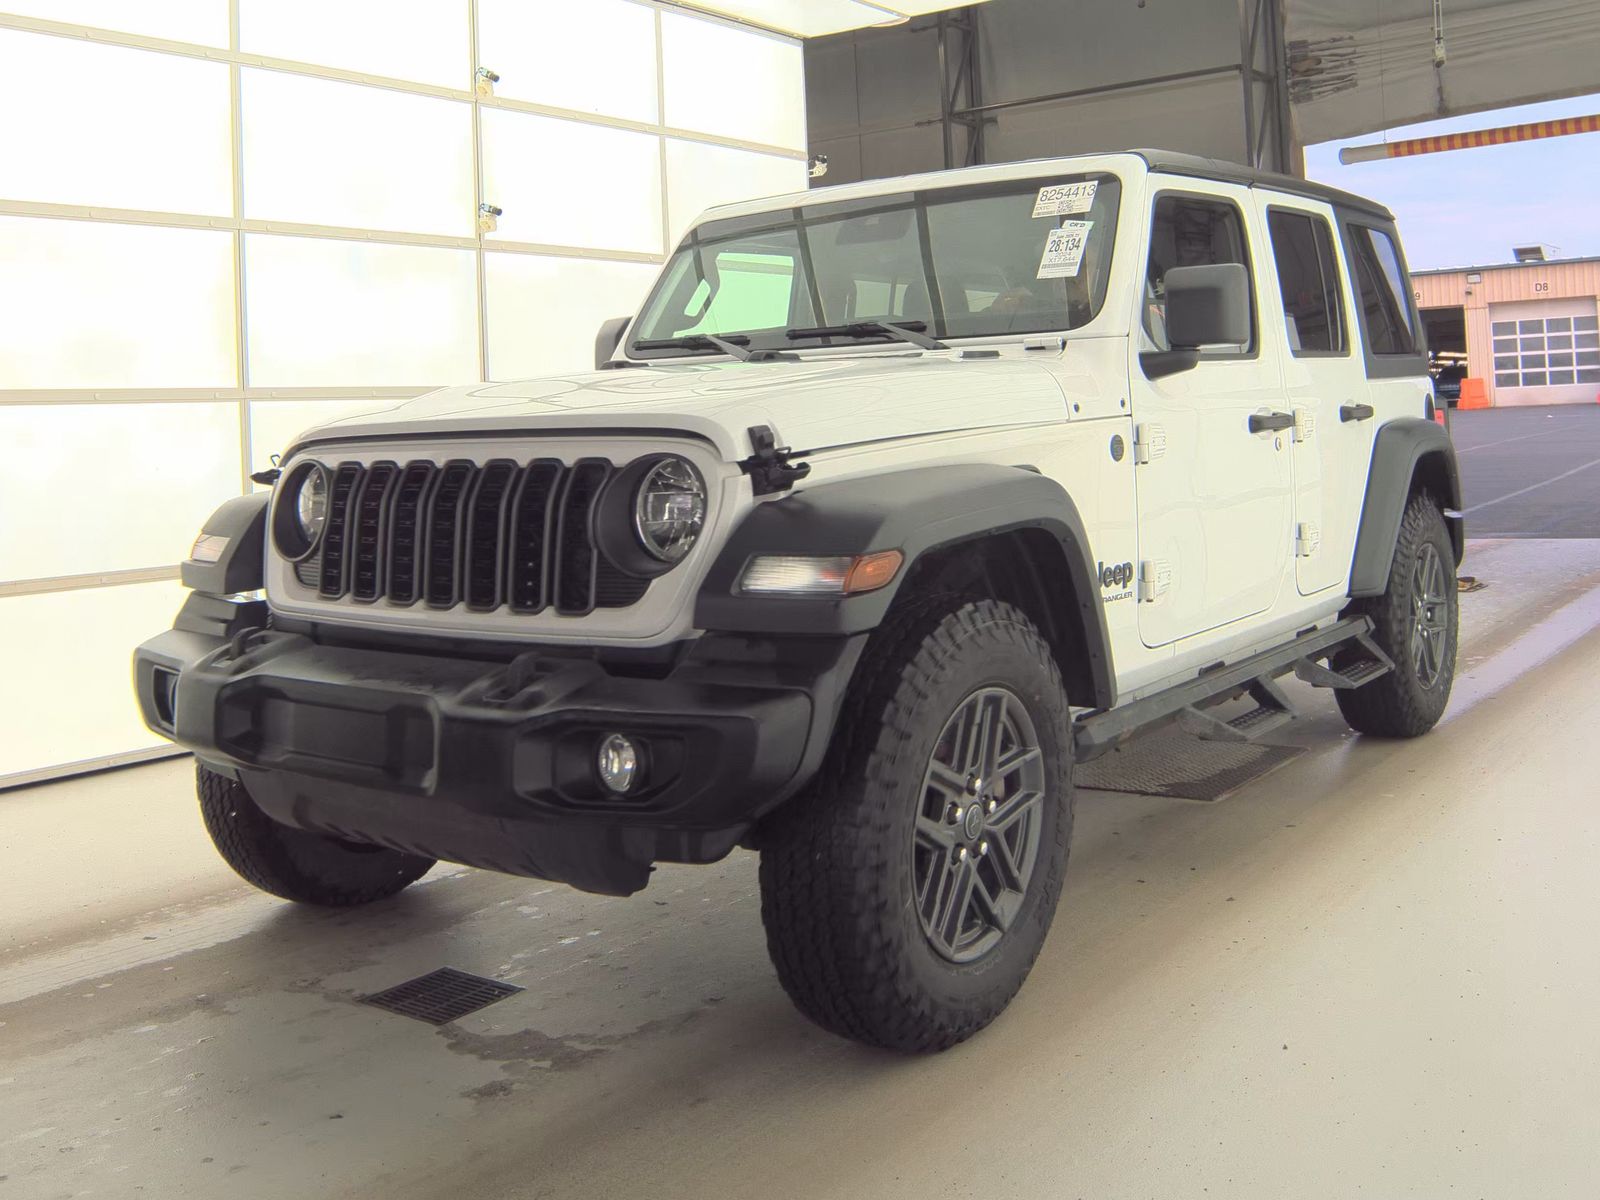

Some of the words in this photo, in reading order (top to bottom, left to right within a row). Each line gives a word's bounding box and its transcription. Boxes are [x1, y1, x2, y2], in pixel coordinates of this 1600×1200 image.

[1040, 184, 1096, 202] 8254413
[1048, 237, 1081, 252] 28:134
[1535, 282, 1549, 292] D8
